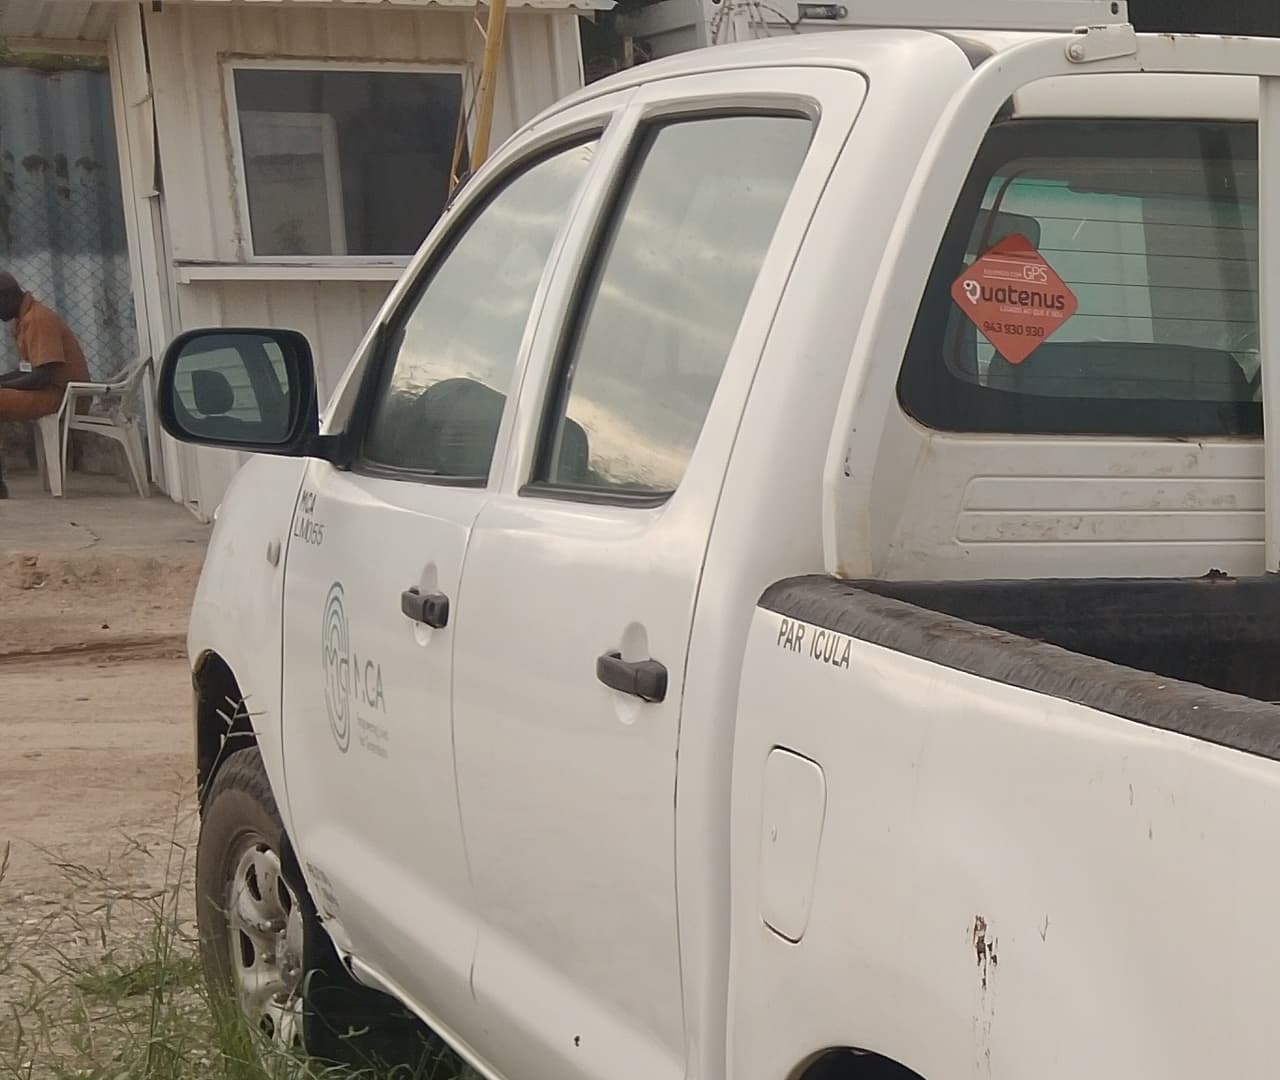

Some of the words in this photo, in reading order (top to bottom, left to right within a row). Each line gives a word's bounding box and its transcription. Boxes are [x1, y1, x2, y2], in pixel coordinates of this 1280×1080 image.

[1023, 265, 1048, 282] GPS
[963, 280, 1065, 310] Quatenus
[983, 321, 1002, 333] 943
[1004, 324, 1024, 336] 930
[1026, 325, 1045, 337] 930
